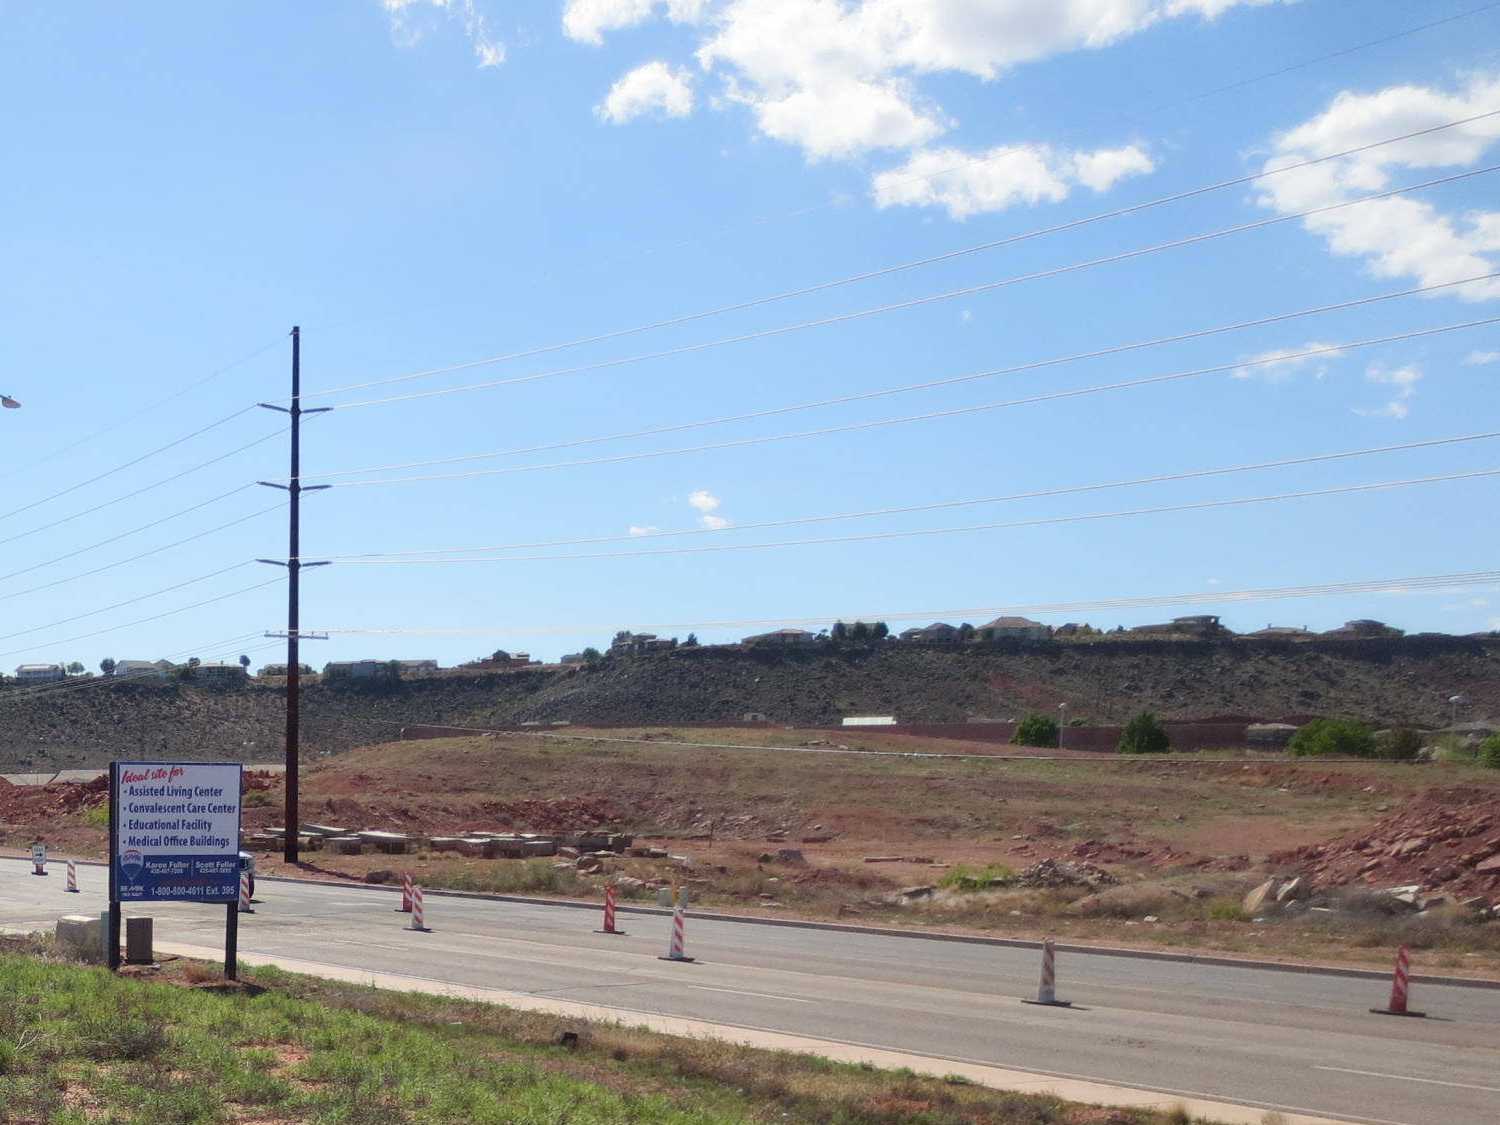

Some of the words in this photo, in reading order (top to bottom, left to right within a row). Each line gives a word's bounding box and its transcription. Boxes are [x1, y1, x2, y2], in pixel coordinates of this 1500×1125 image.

[121, 768, 150, 784] Ideal
[151, 767, 168, 780] site
[168, 765, 184, 783] for
[128, 785, 165, 797] Assisted
[166, 785, 193, 799] Living
[194, 786, 223, 797] Center
[128, 802, 186, 813] Convalescent
[187, 803, 206, 813] Care
[207, 803, 236, 814] Center
[128, 819, 180, 830] Educational
[181, 819, 212, 832] Facility
[128, 835, 162, 847] Medical
[163, 835, 188, 846] Office
[190, 835, 230, 849] Buildings
[145, 861, 167, 869] Karen
[169, 861, 190, 869] Fuller
[151, 886, 204, 896] 1-800-800-4611
[205, 885, 219, 895] Ext.
